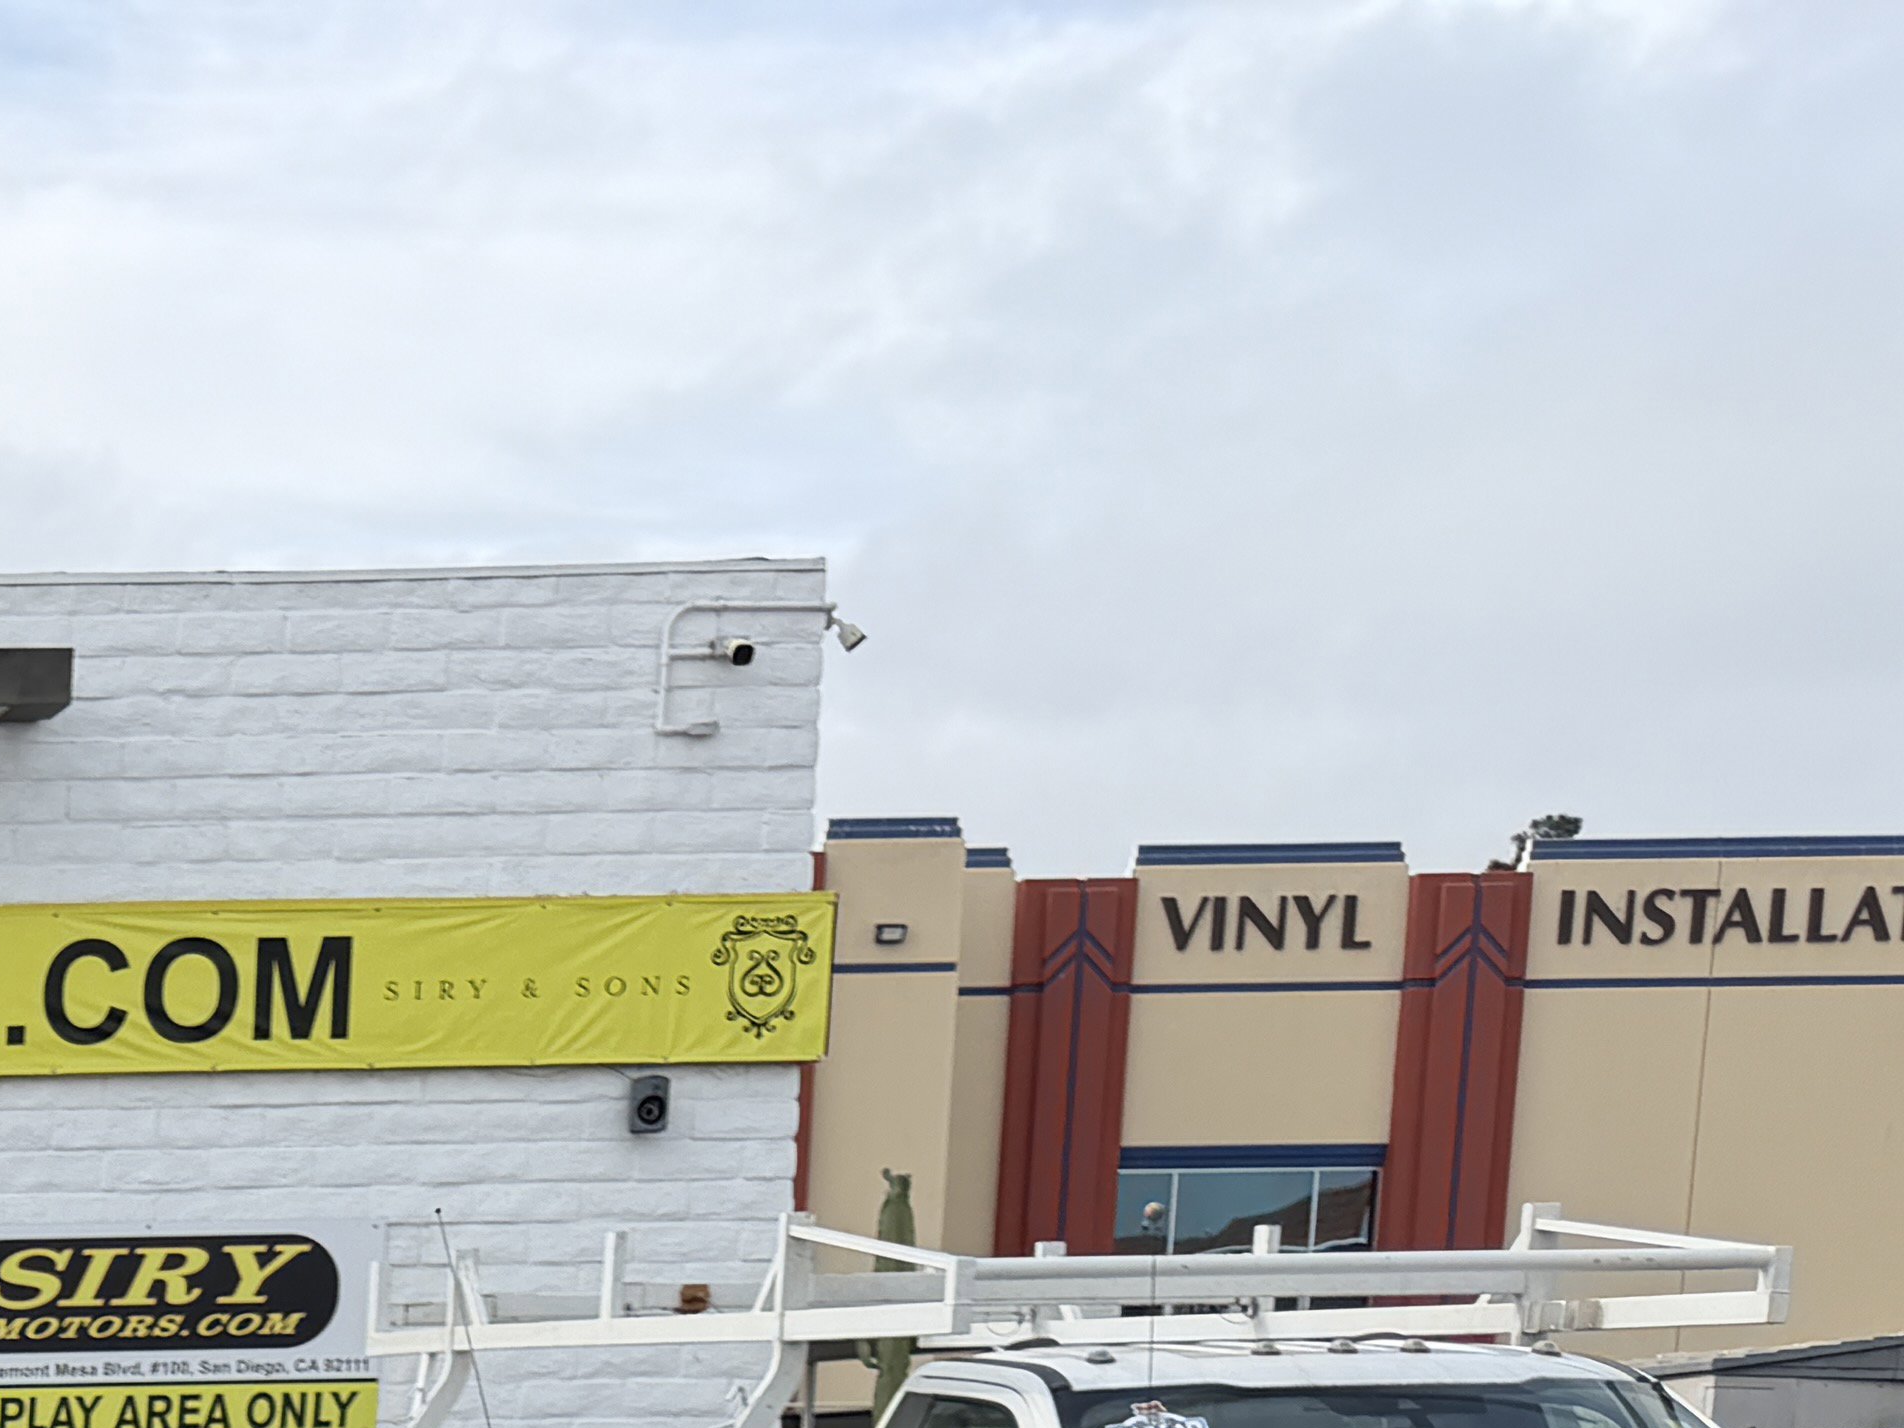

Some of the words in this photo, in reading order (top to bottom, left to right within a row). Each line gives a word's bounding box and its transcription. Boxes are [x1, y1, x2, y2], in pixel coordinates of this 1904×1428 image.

[1160, 894, 1372, 952] VINYL
[383, 978, 488, 1002] SIRY
[521, 977, 539, 999] &
[575, 974, 691, 998] SONS
[55, 1361, 97, 1378] Mesa
[198, 1360, 232, 1375] San
[294, 1358, 320, 1374] CA
